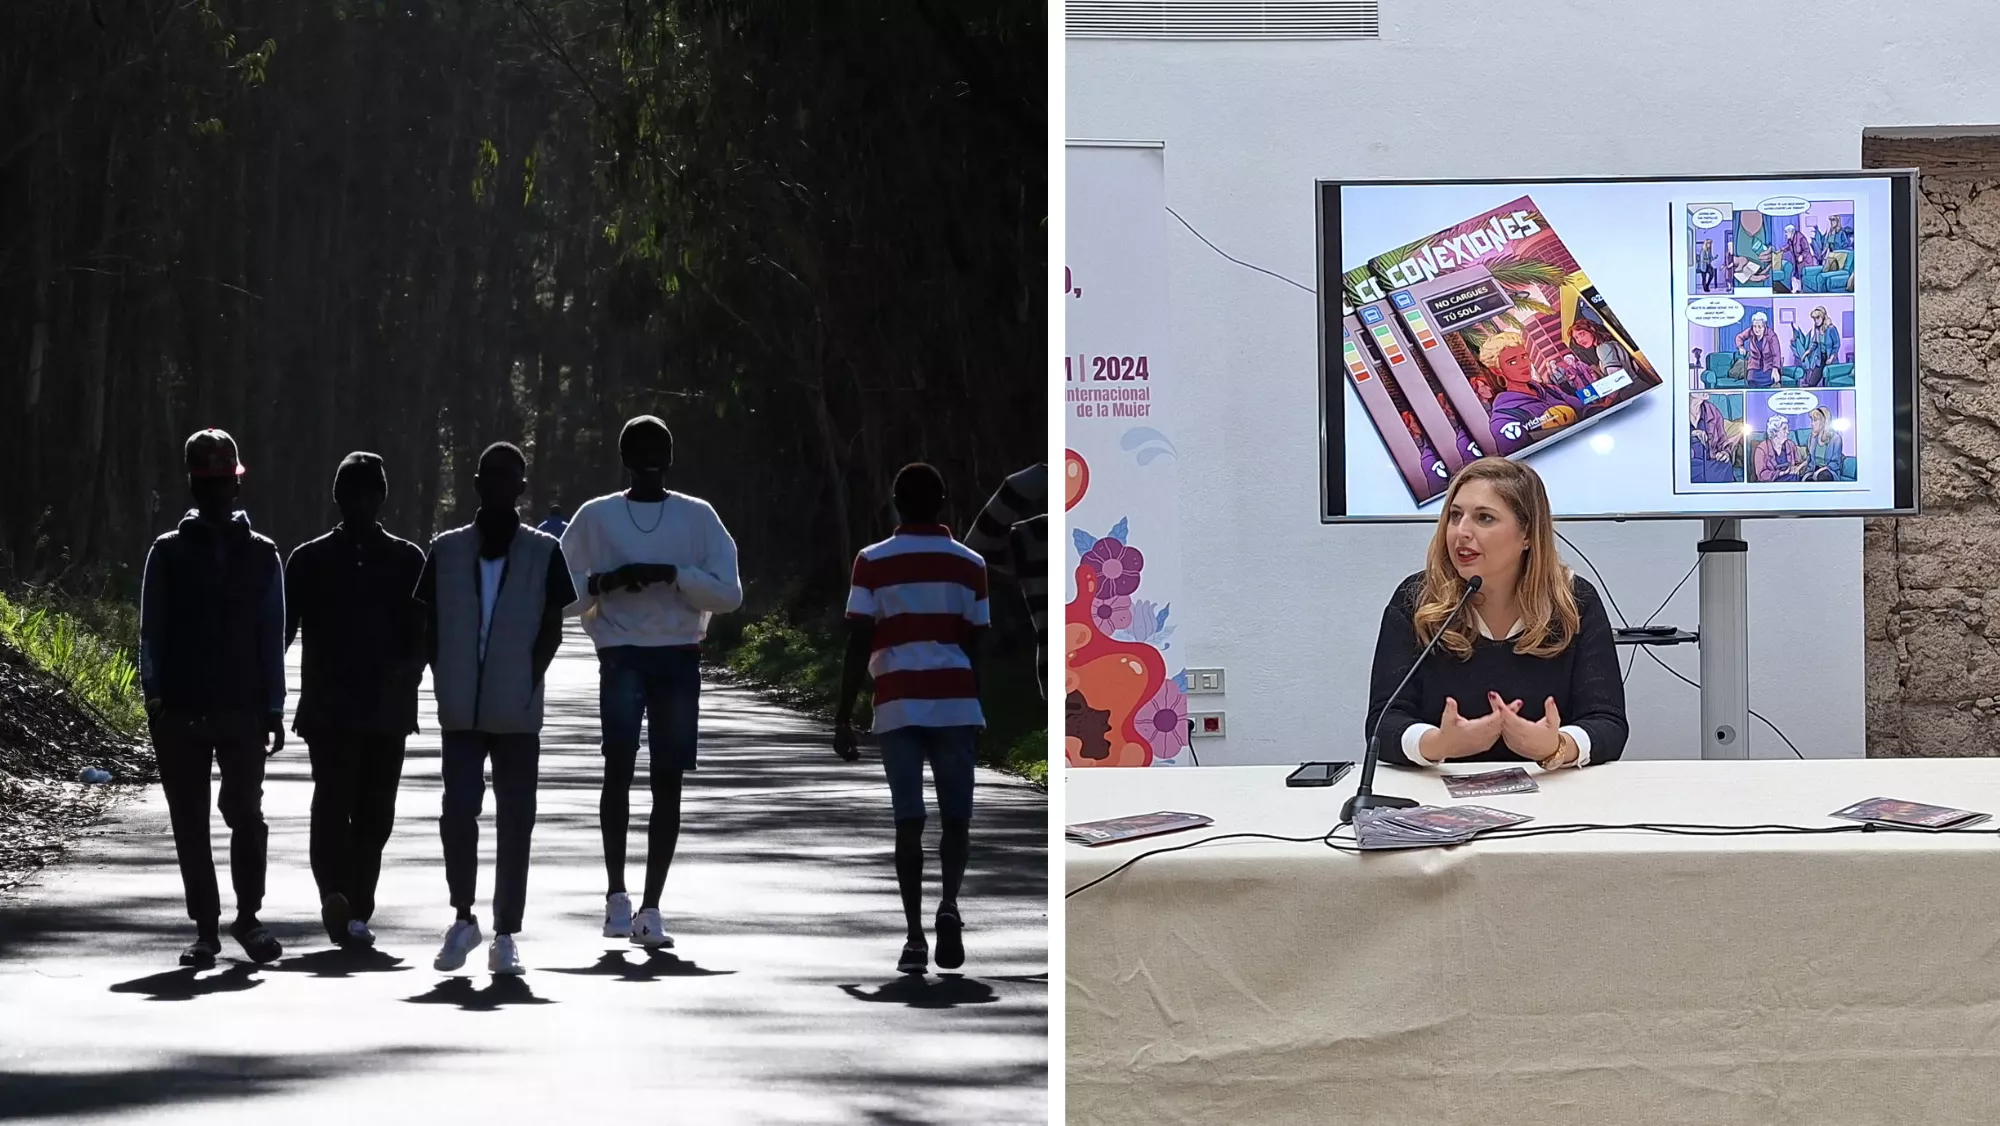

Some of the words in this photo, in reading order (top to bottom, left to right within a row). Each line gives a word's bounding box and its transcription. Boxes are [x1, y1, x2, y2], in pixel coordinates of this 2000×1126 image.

[1386, 210, 1541, 282] CONEXIONES
[1434, 299, 1450, 309] NO
[1450, 286, 1489, 304] CARGUES
[1443, 311, 1457, 322] TÚ
[1456, 304, 1481, 318] SOLA
[1092, 356, 1149, 381] 2024
[1076, 403, 1093, 417] de
[1097, 403, 1109, 417] la
[1112, 402, 1151, 418] Mujer
